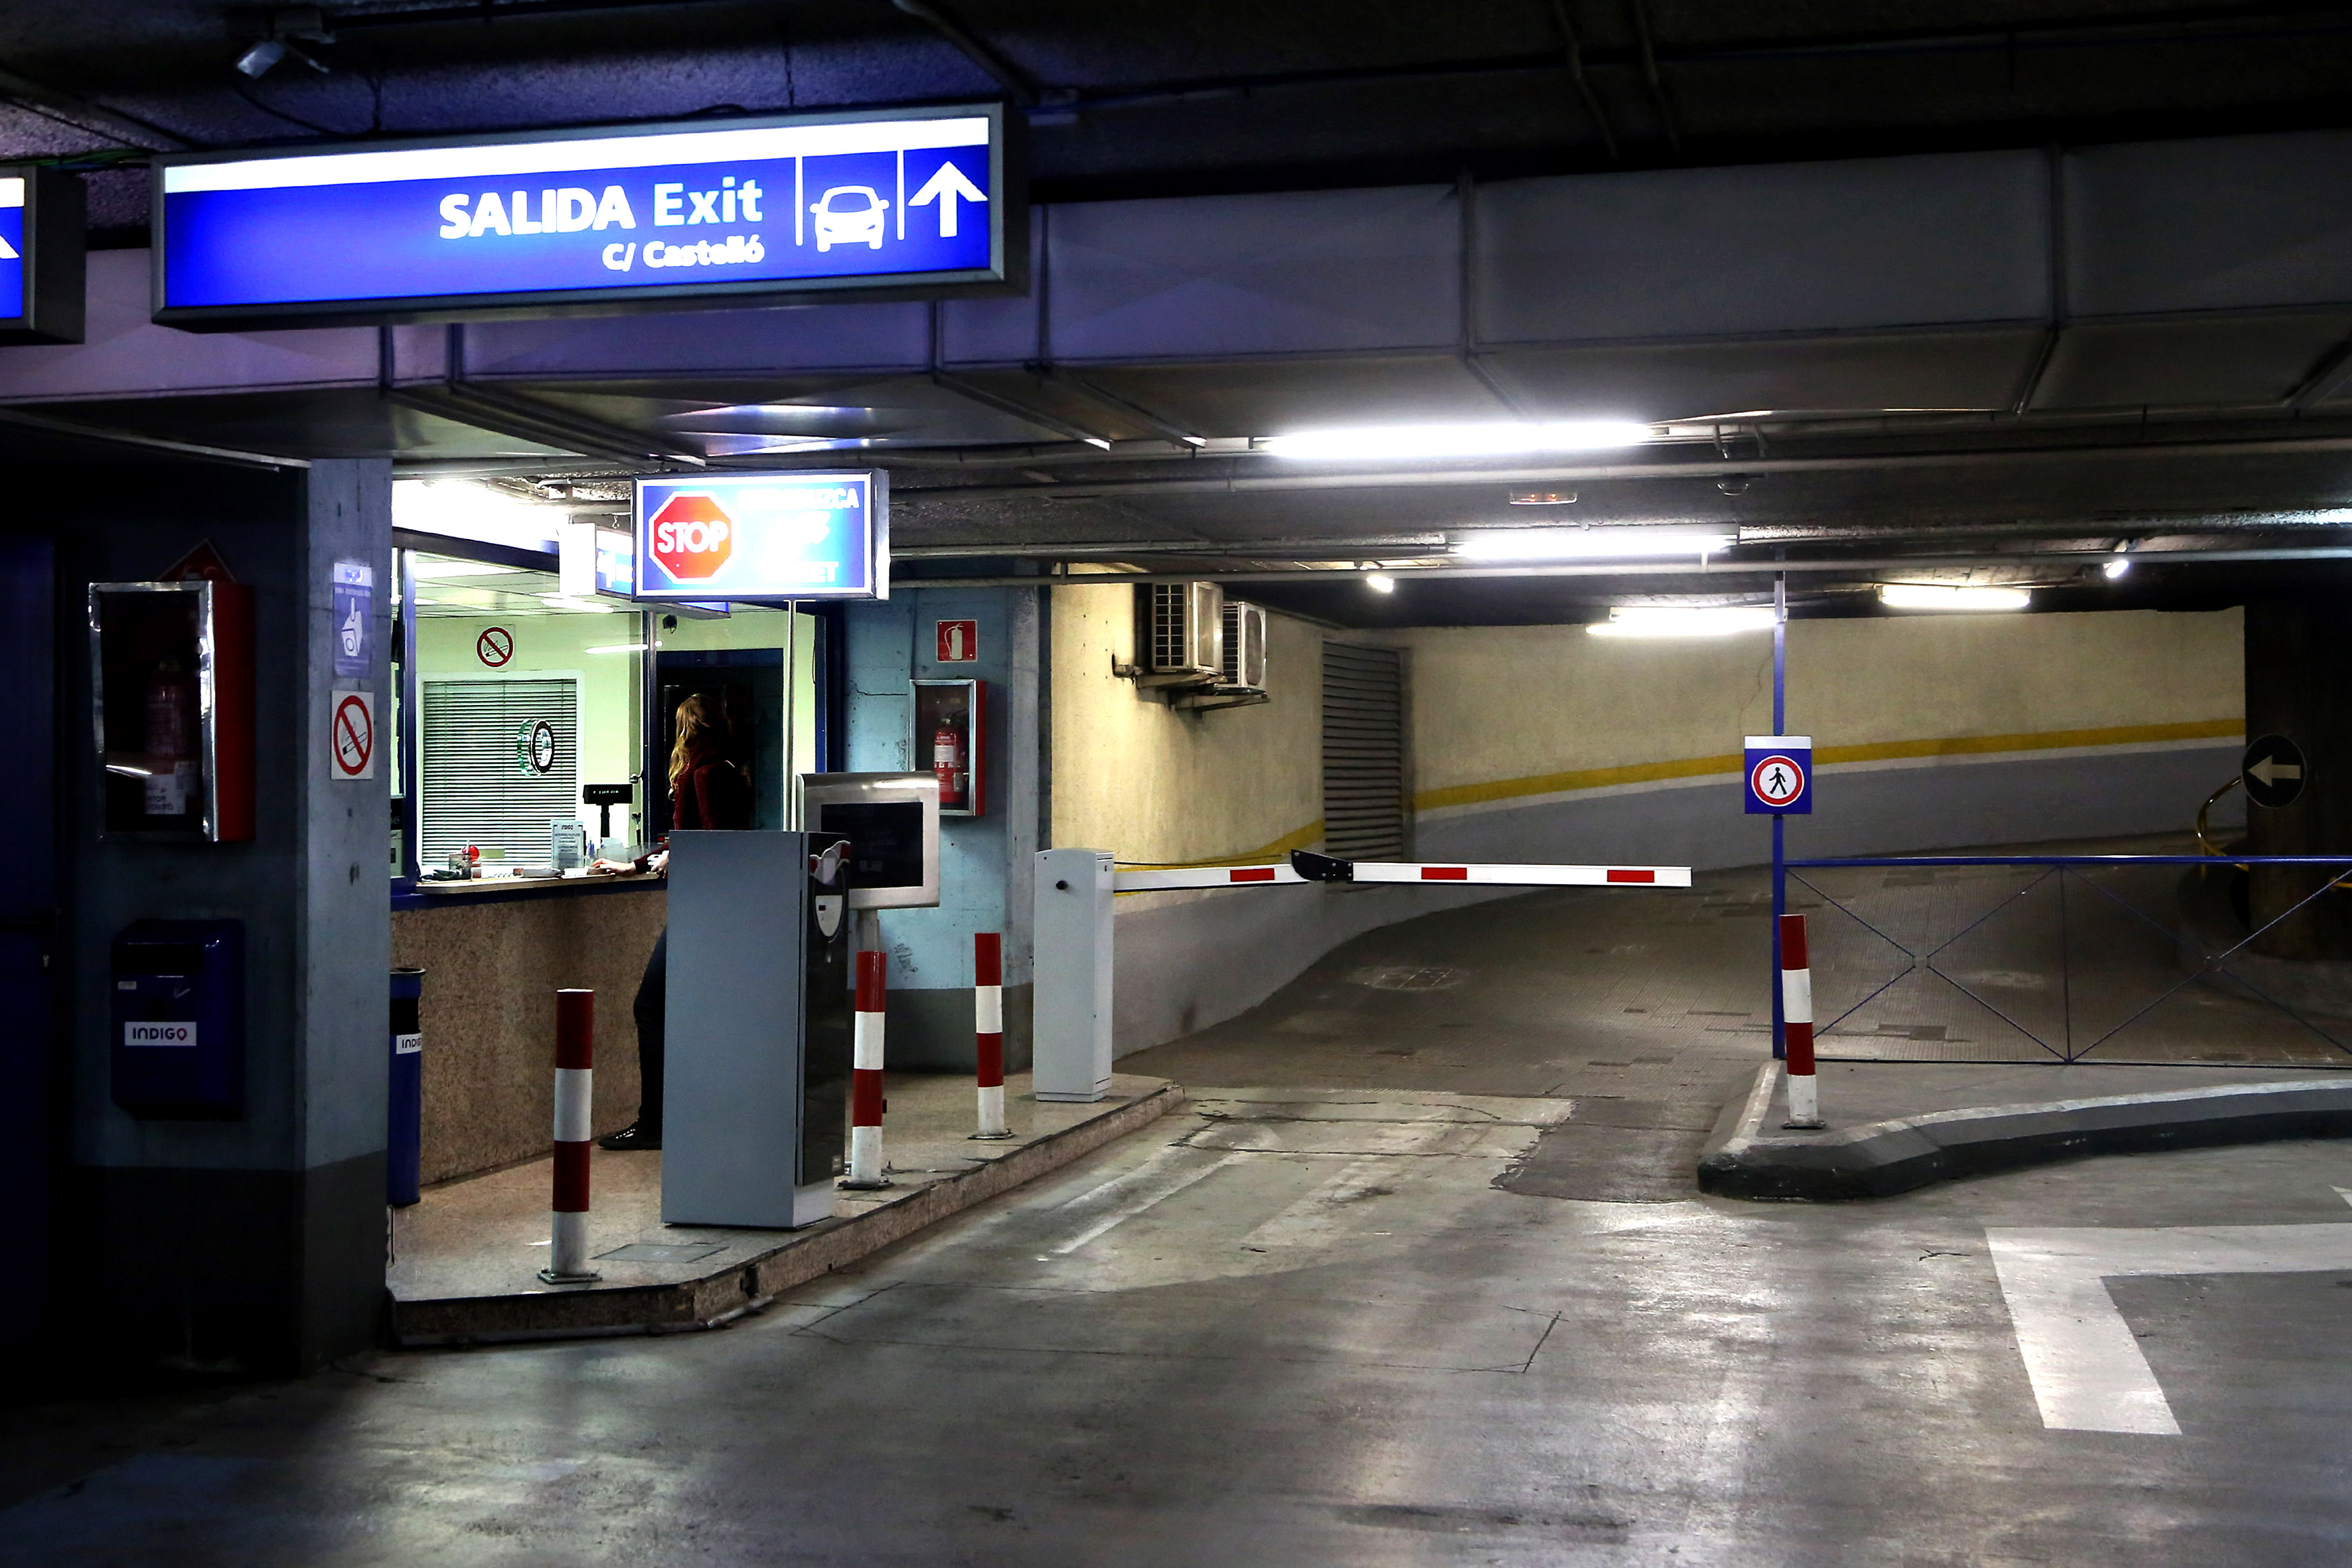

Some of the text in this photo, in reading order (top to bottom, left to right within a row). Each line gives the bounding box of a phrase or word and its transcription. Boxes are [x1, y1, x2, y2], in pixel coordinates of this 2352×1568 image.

[439, 176, 763, 239] SALIDA Exit
[602, 234, 765, 272] C/ Castelló
[657, 520, 728, 554] STOP
[133, 1028, 187, 1041] INDIGO
